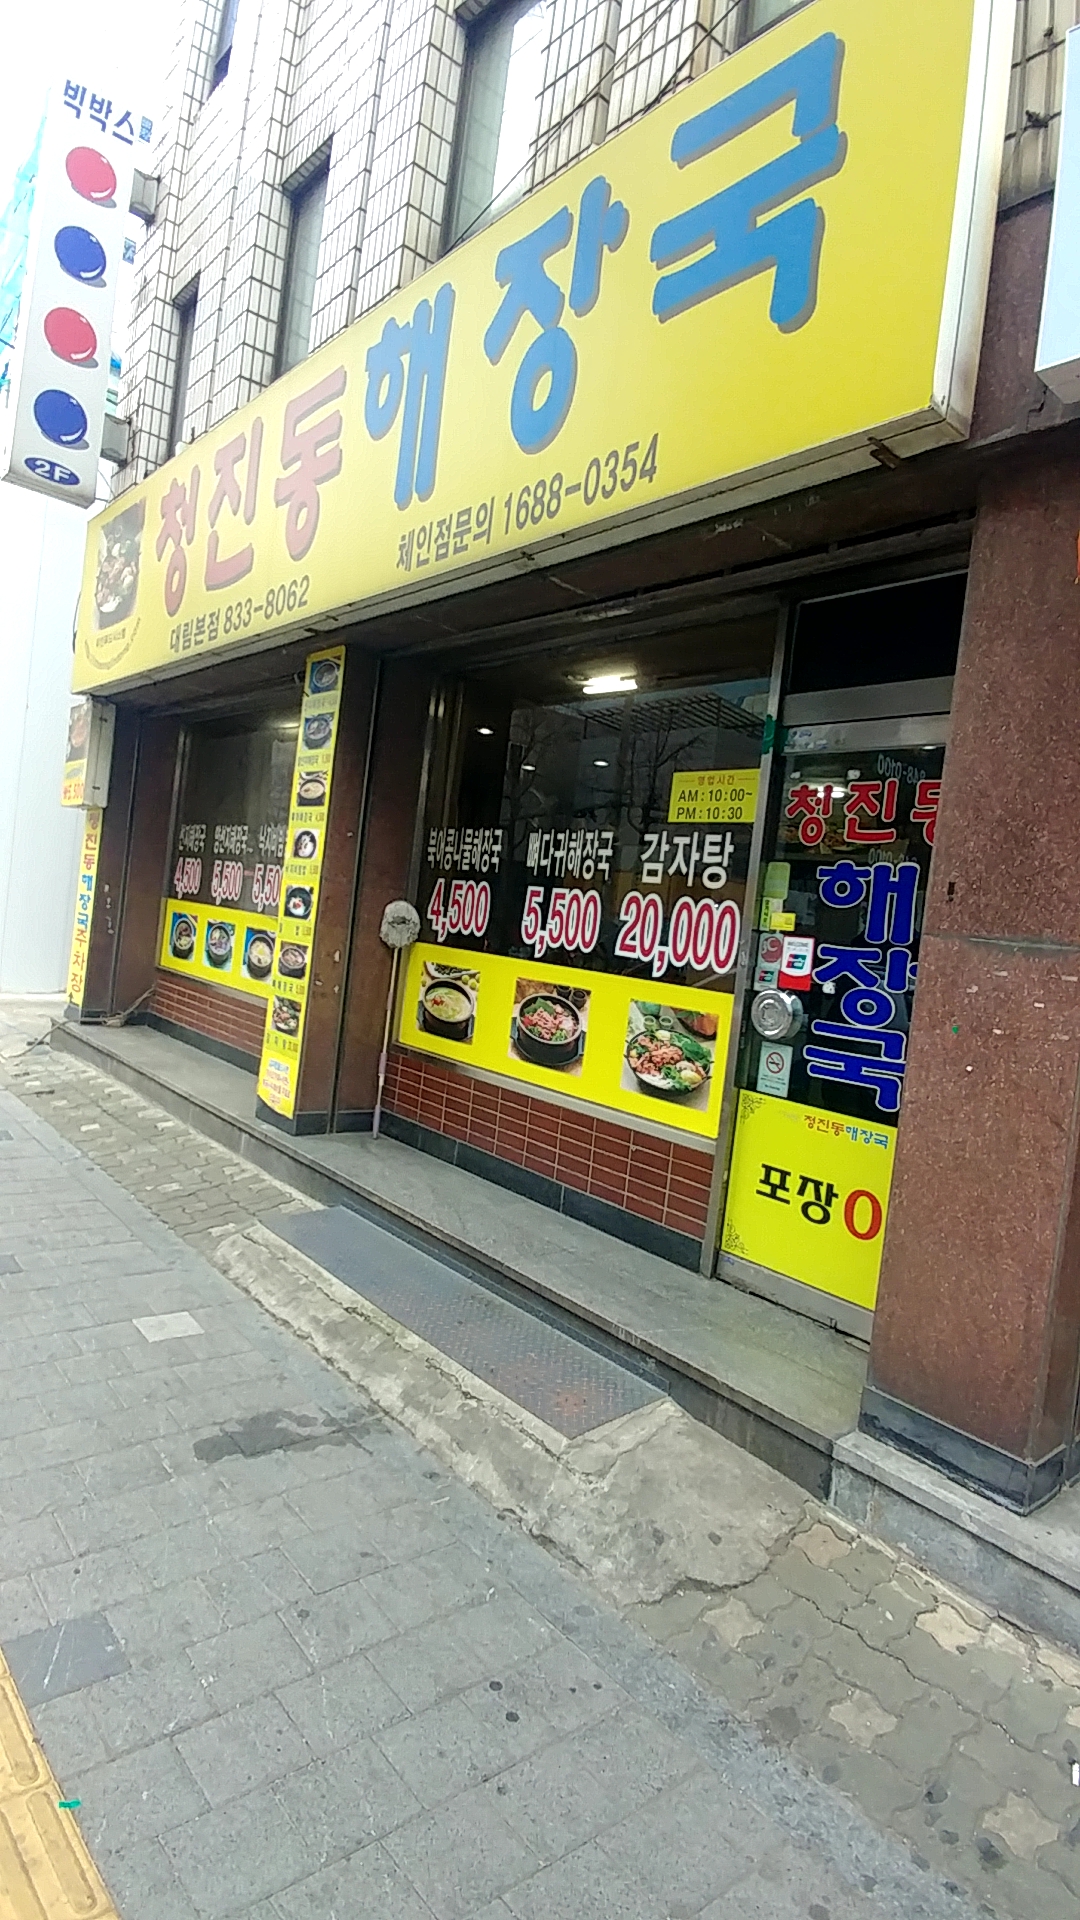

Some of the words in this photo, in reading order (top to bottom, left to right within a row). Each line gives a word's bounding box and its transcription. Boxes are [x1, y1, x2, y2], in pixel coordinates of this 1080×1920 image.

[63, 79, 134, 146] 빅박스
[156, 366, 346, 618] 청진동
[364, 31, 848, 512] 해장국
[34, 460, 71, 483] 2F
[395, 495, 496, 573] 체인점문의
[503, 432, 659, 536] 1688-0354
[169, 607, 221, 653] 대림본점
[222, 574, 311, 635] 833-8062
[697, 775, 735, 786] 영업시간
[173, 856, 202, 899] 4,500
[427, 827, 503, 873] 북어콩나물해장국
[526, 828, 614, 881] 뼈다귀해장국
[640, 830, 735, 889] 감자탕
[211, 859, 243, 905] 5,500
[252, 863, 282, 912] 5,50
[427, 878, 491, 942] 4,500
[521, 886, 601, 958] 5,500
[614, 891, 741, 977] 20,000
[803, 860, 920, 1112] 해장국
[755, 1163, 839, 1225] 포장
